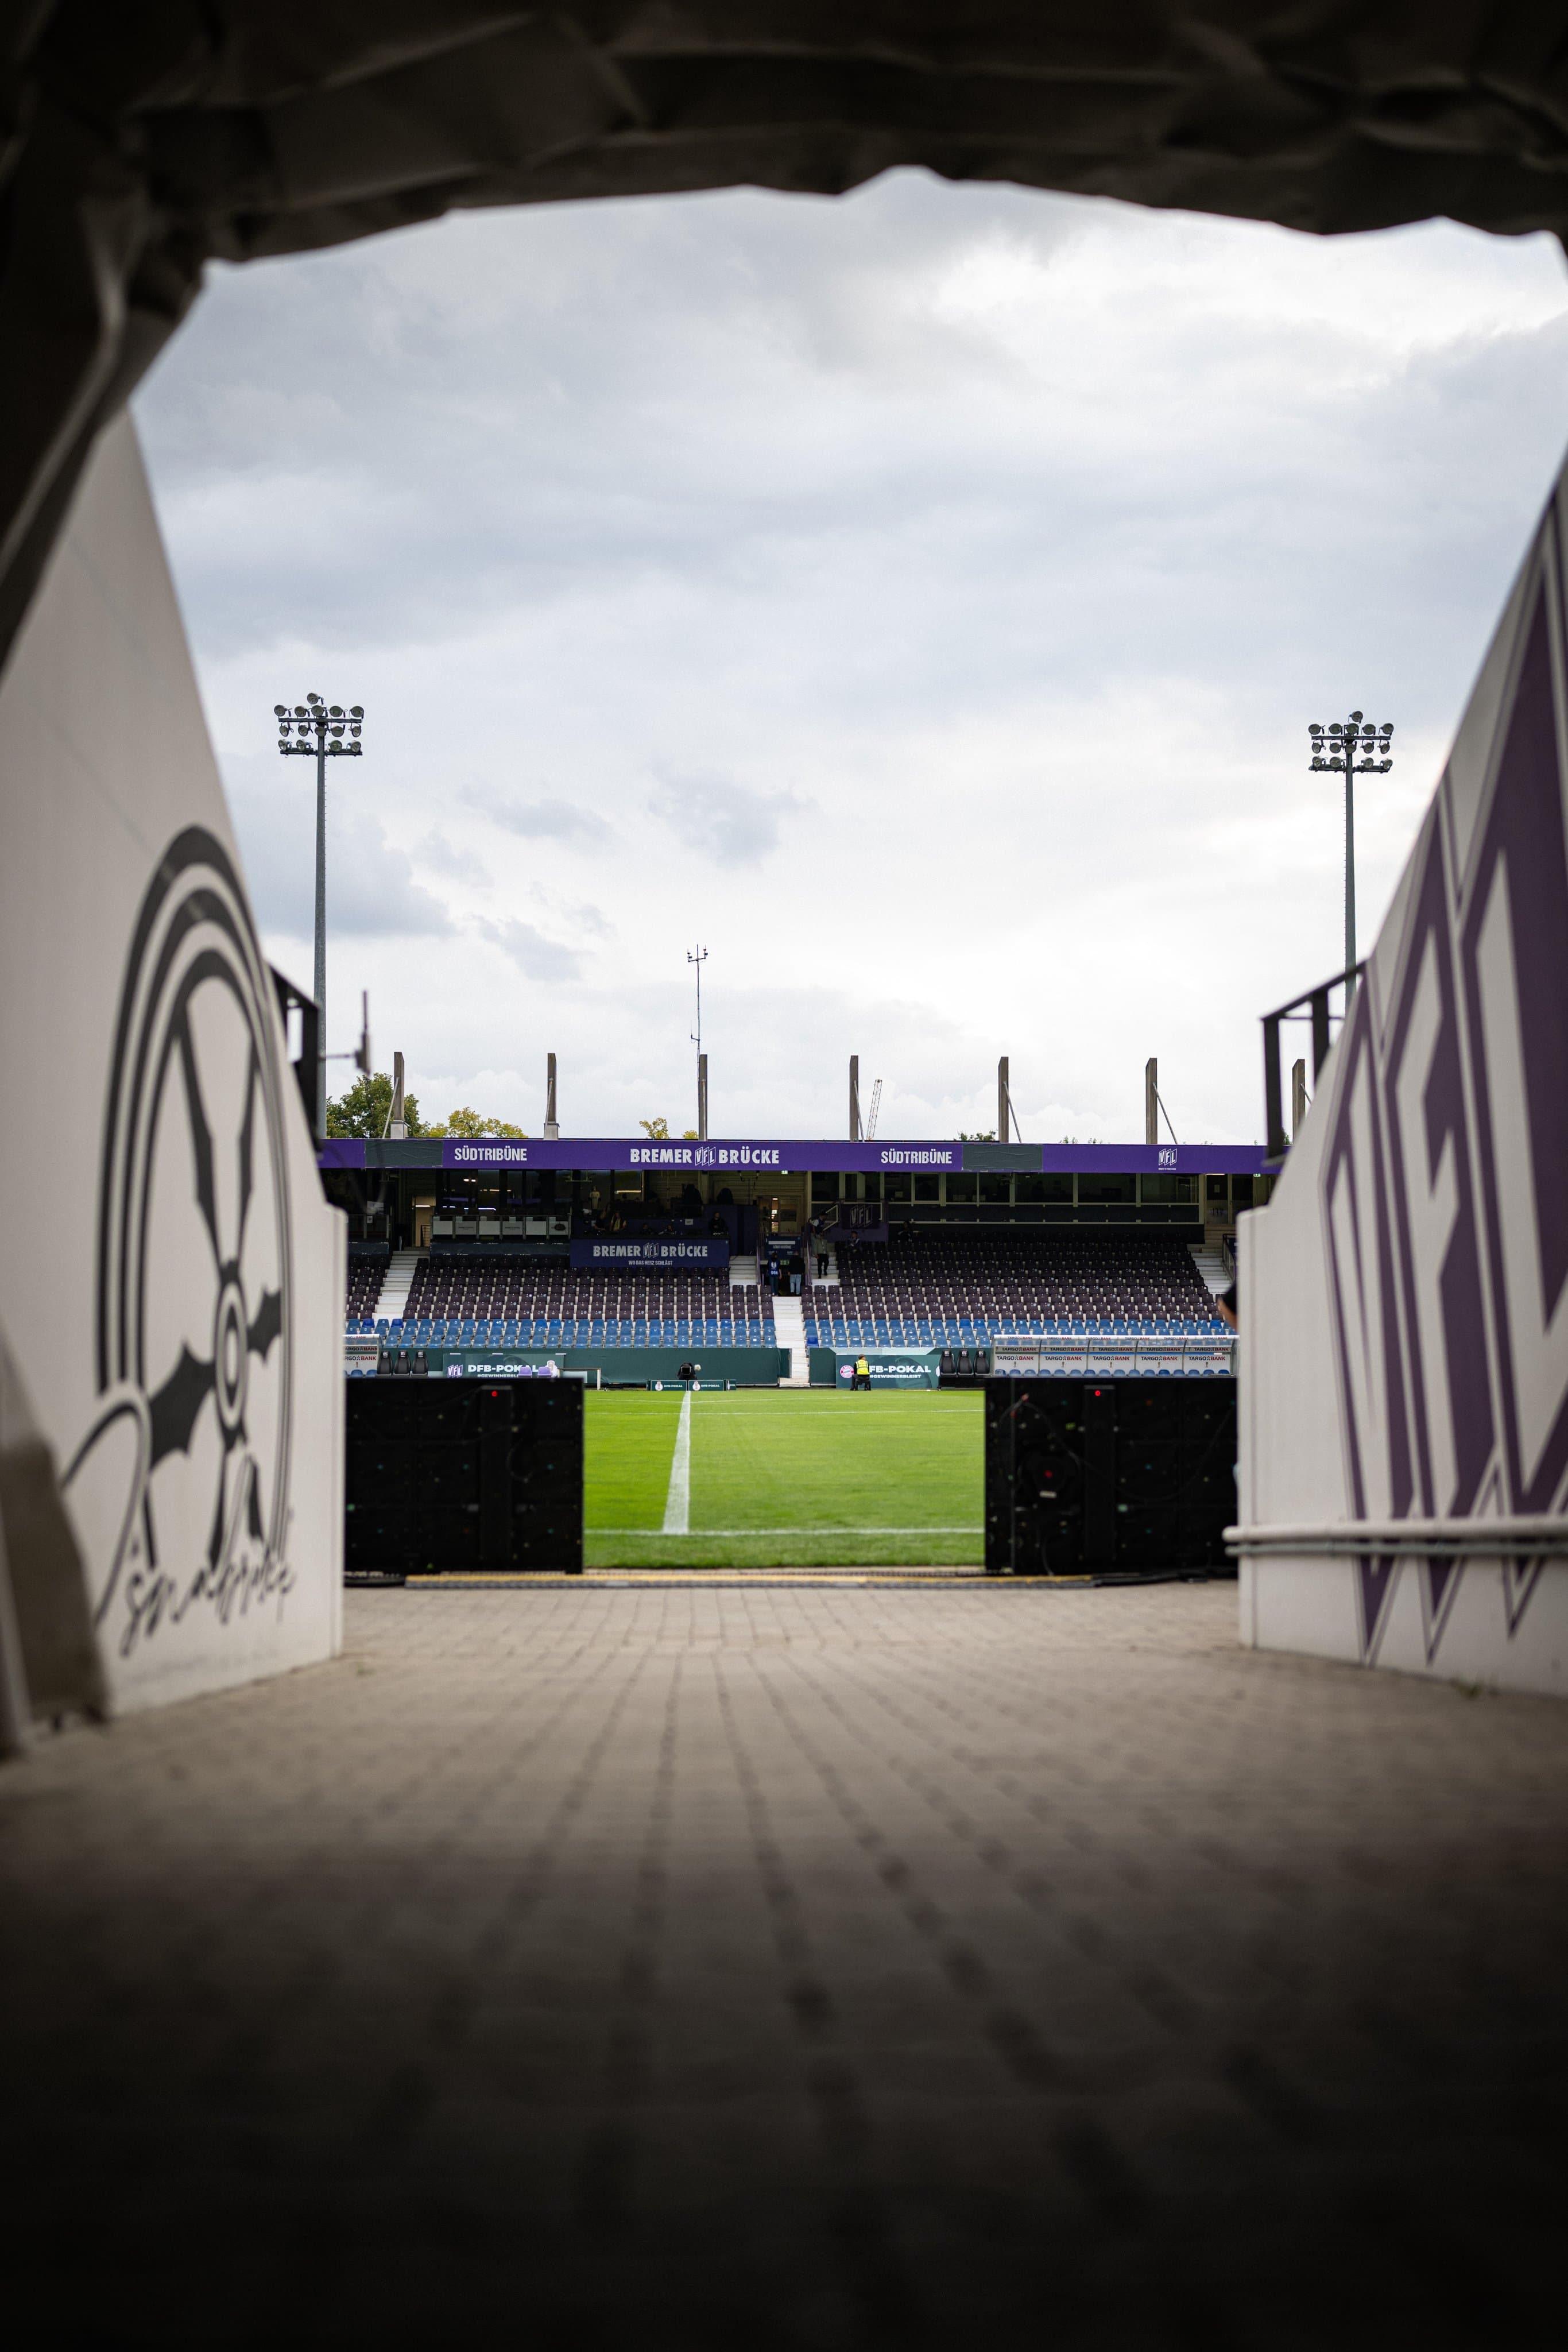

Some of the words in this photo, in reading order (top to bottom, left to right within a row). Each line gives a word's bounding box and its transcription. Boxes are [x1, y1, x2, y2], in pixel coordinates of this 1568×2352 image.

[454, 1145, 527, 1161] SÜDTRIBÜNE
[630, 1148, 692, 1163] BREMER
[718, 1146, 780, 1164] BRÜCKE
[881, 1148, 953, 1164] SÜDTRIBÜNE
[593, 1245, 641, 1257] BREMER
[661, 1243, 708, 1257] BRÜCKE
[447, 1365, 463, 1378] VFL
[468, 1364, 539, 1372] DFB-POKL
[869, 1365, 931, 1373] FB-POKAL
